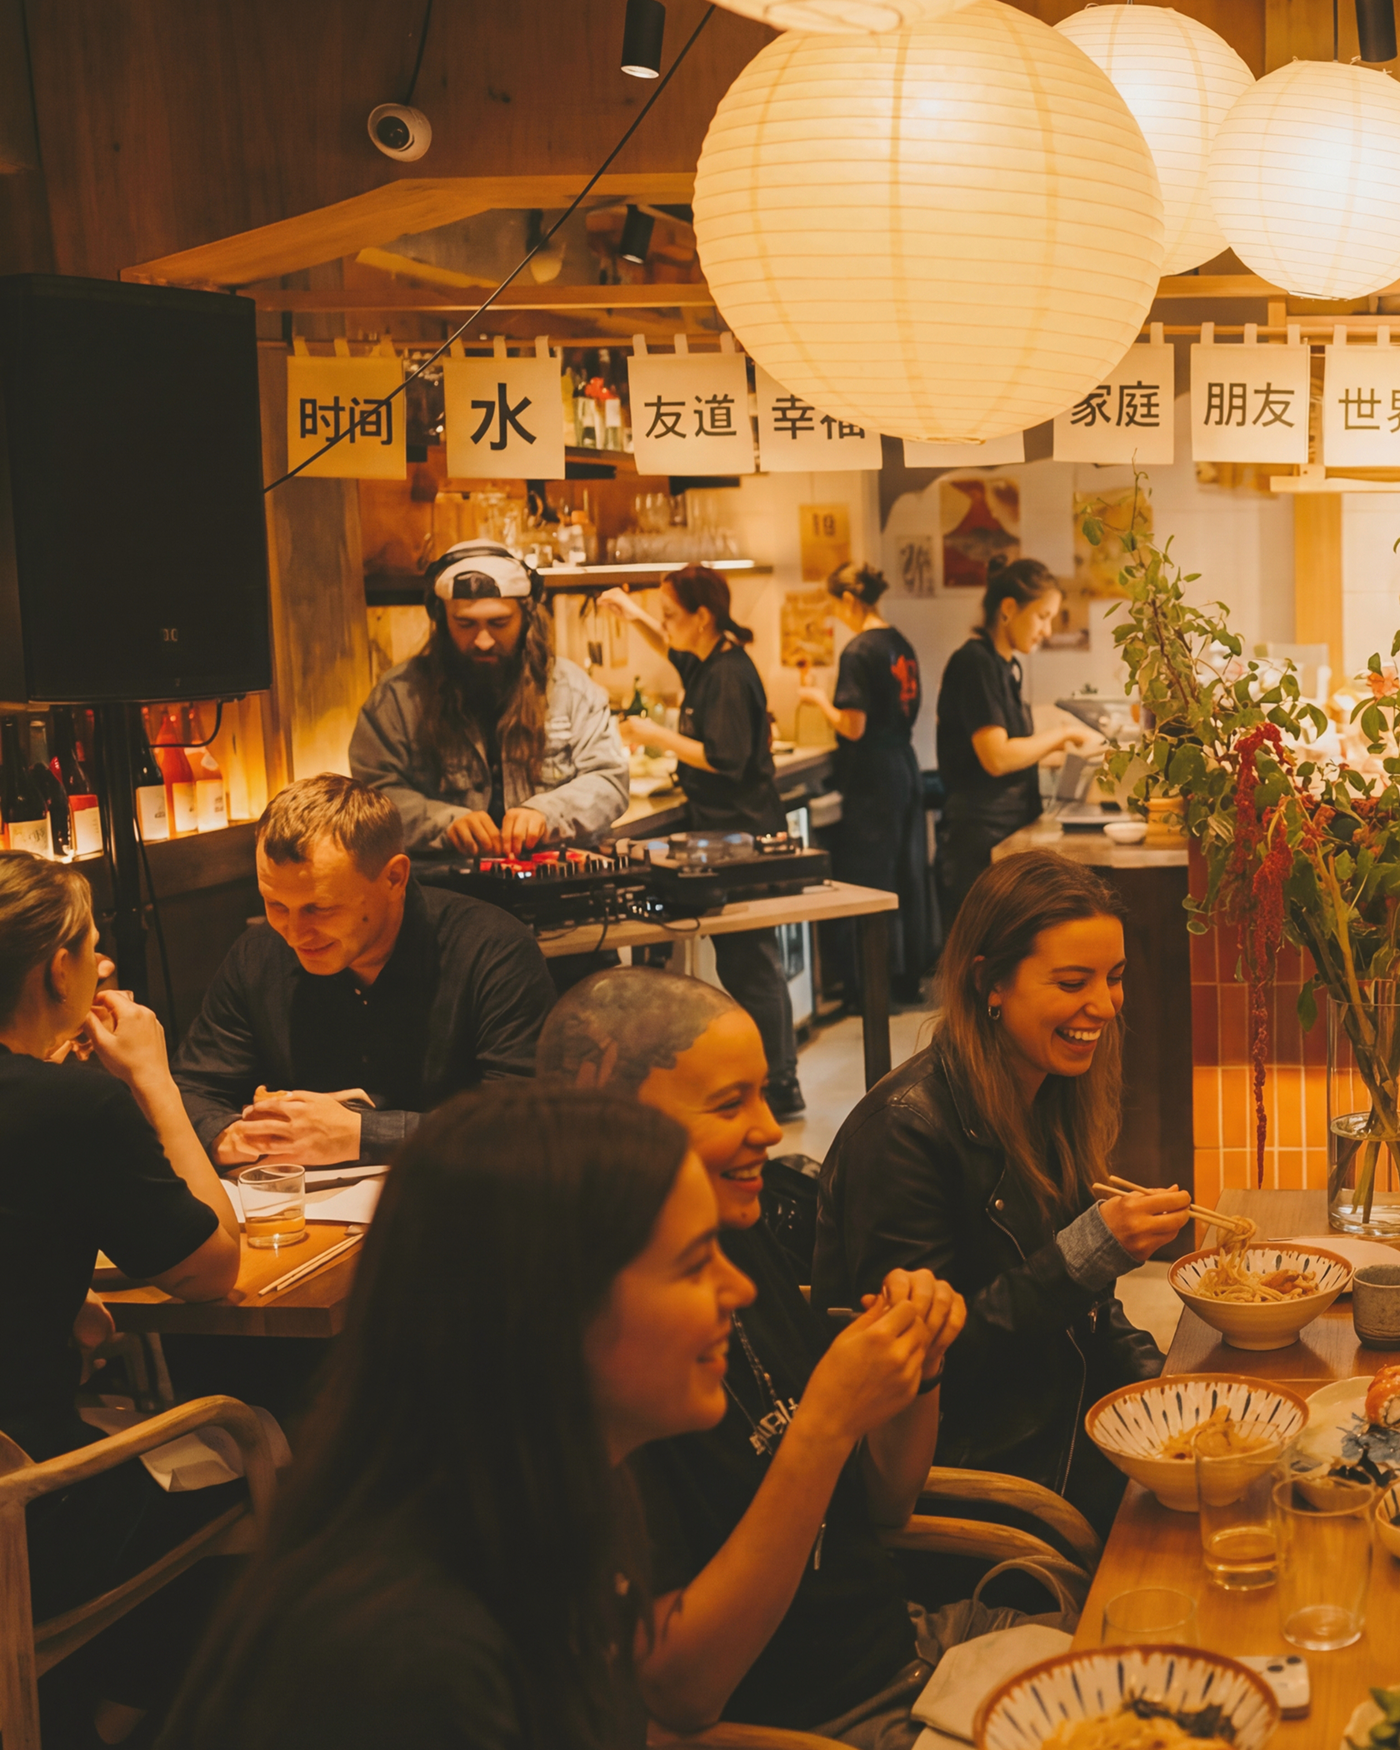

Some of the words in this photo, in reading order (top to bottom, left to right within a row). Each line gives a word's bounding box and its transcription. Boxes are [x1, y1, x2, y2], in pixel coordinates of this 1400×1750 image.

[300, 396, 392, 445] 时间
[470, 383, 536, 450] 水
[644, 394, 737, 439] 友道
[1070, 381, 1160, 427] 家庭
[1204, 382, 1294, 428] 朋友
